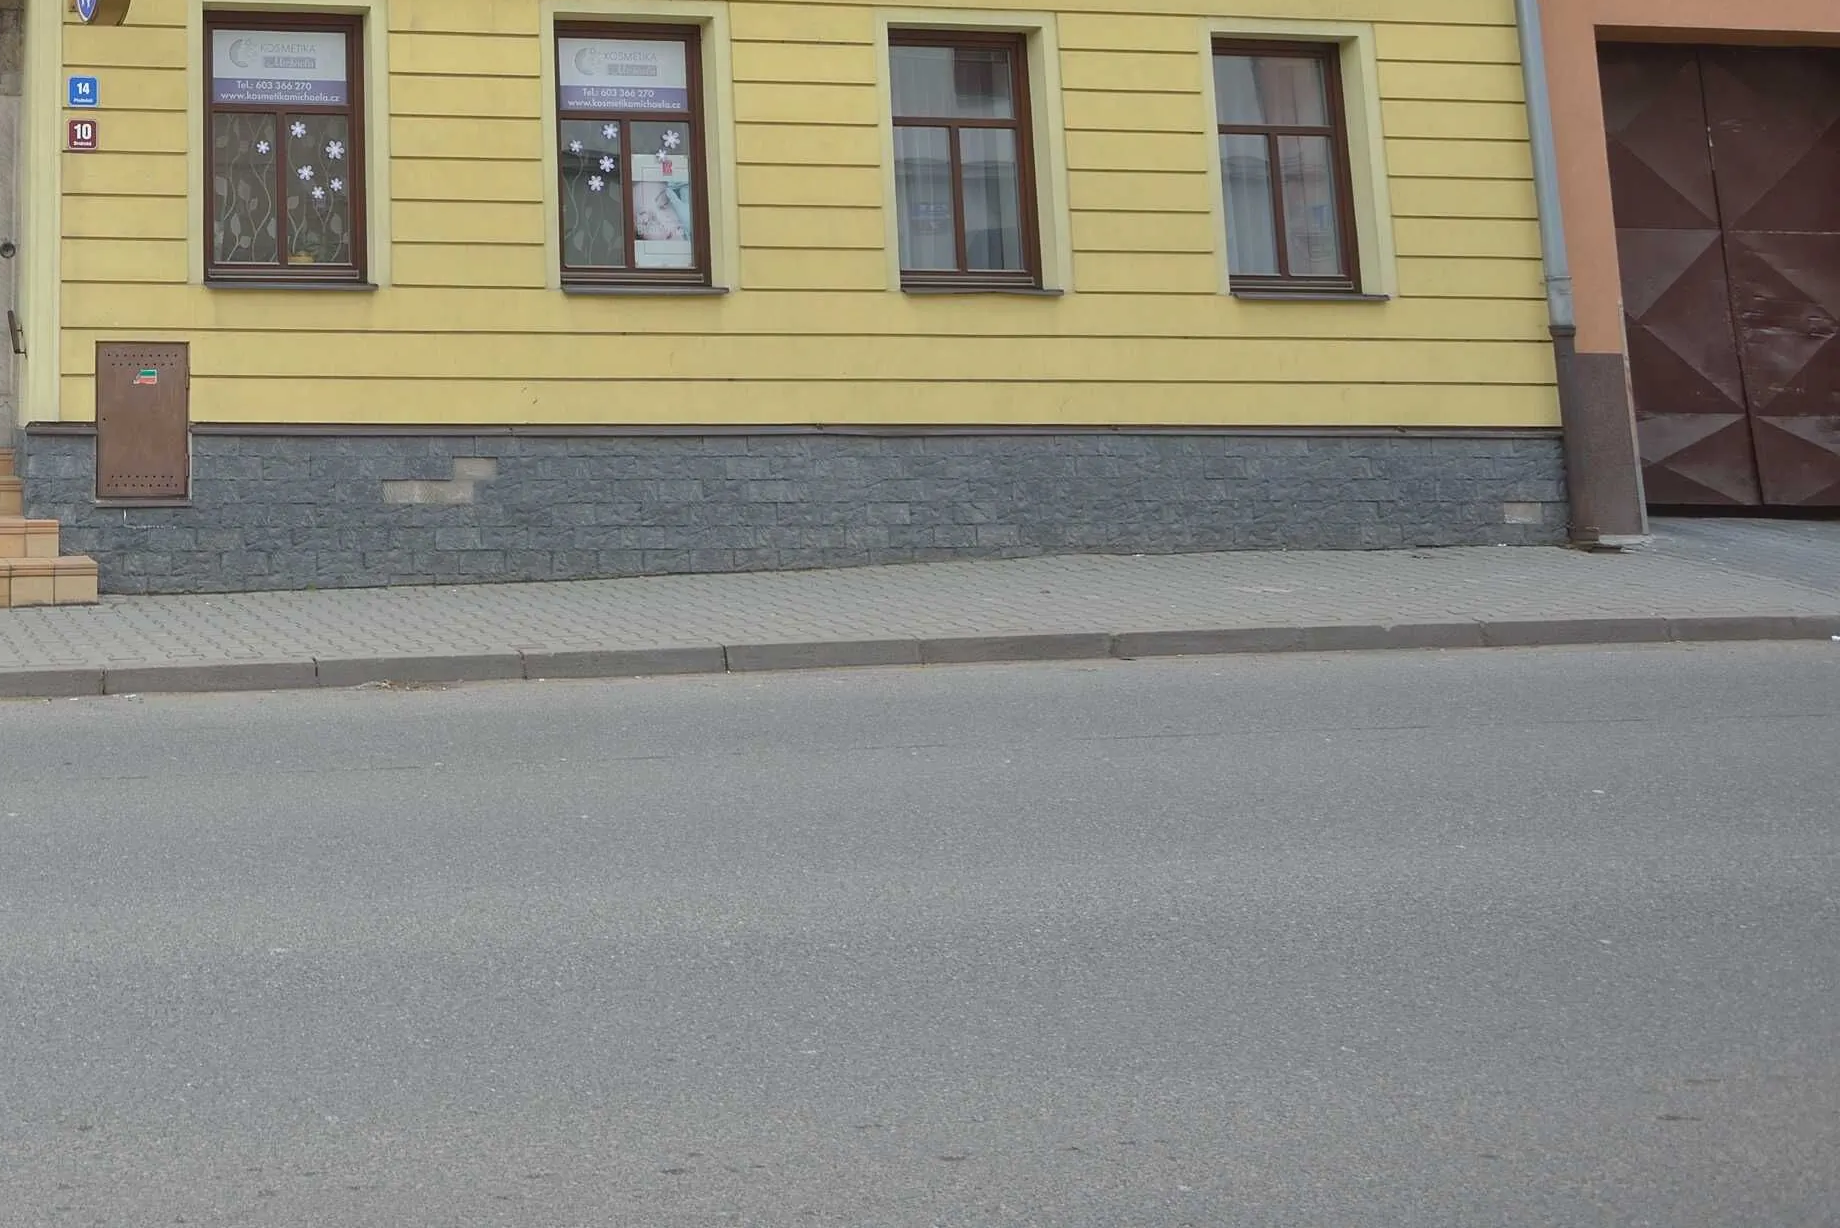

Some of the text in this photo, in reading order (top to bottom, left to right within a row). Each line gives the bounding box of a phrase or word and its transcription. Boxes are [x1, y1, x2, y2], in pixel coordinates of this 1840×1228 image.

[260, 43, 317, 54] KOSMETIKA
[602, 51, 657, 62] KOSMETIKA
[76, 82, 90, 95] 14
[255, 81, 273, 90] 603
[277, 82, 293, 91] 366
[294, 82, 313, 92] 270
[220, 90, 341, 103] www.kosmetikamichaela.cz
[638, 90, 655, 99] 270
[73, 123, 92, 140] 10
